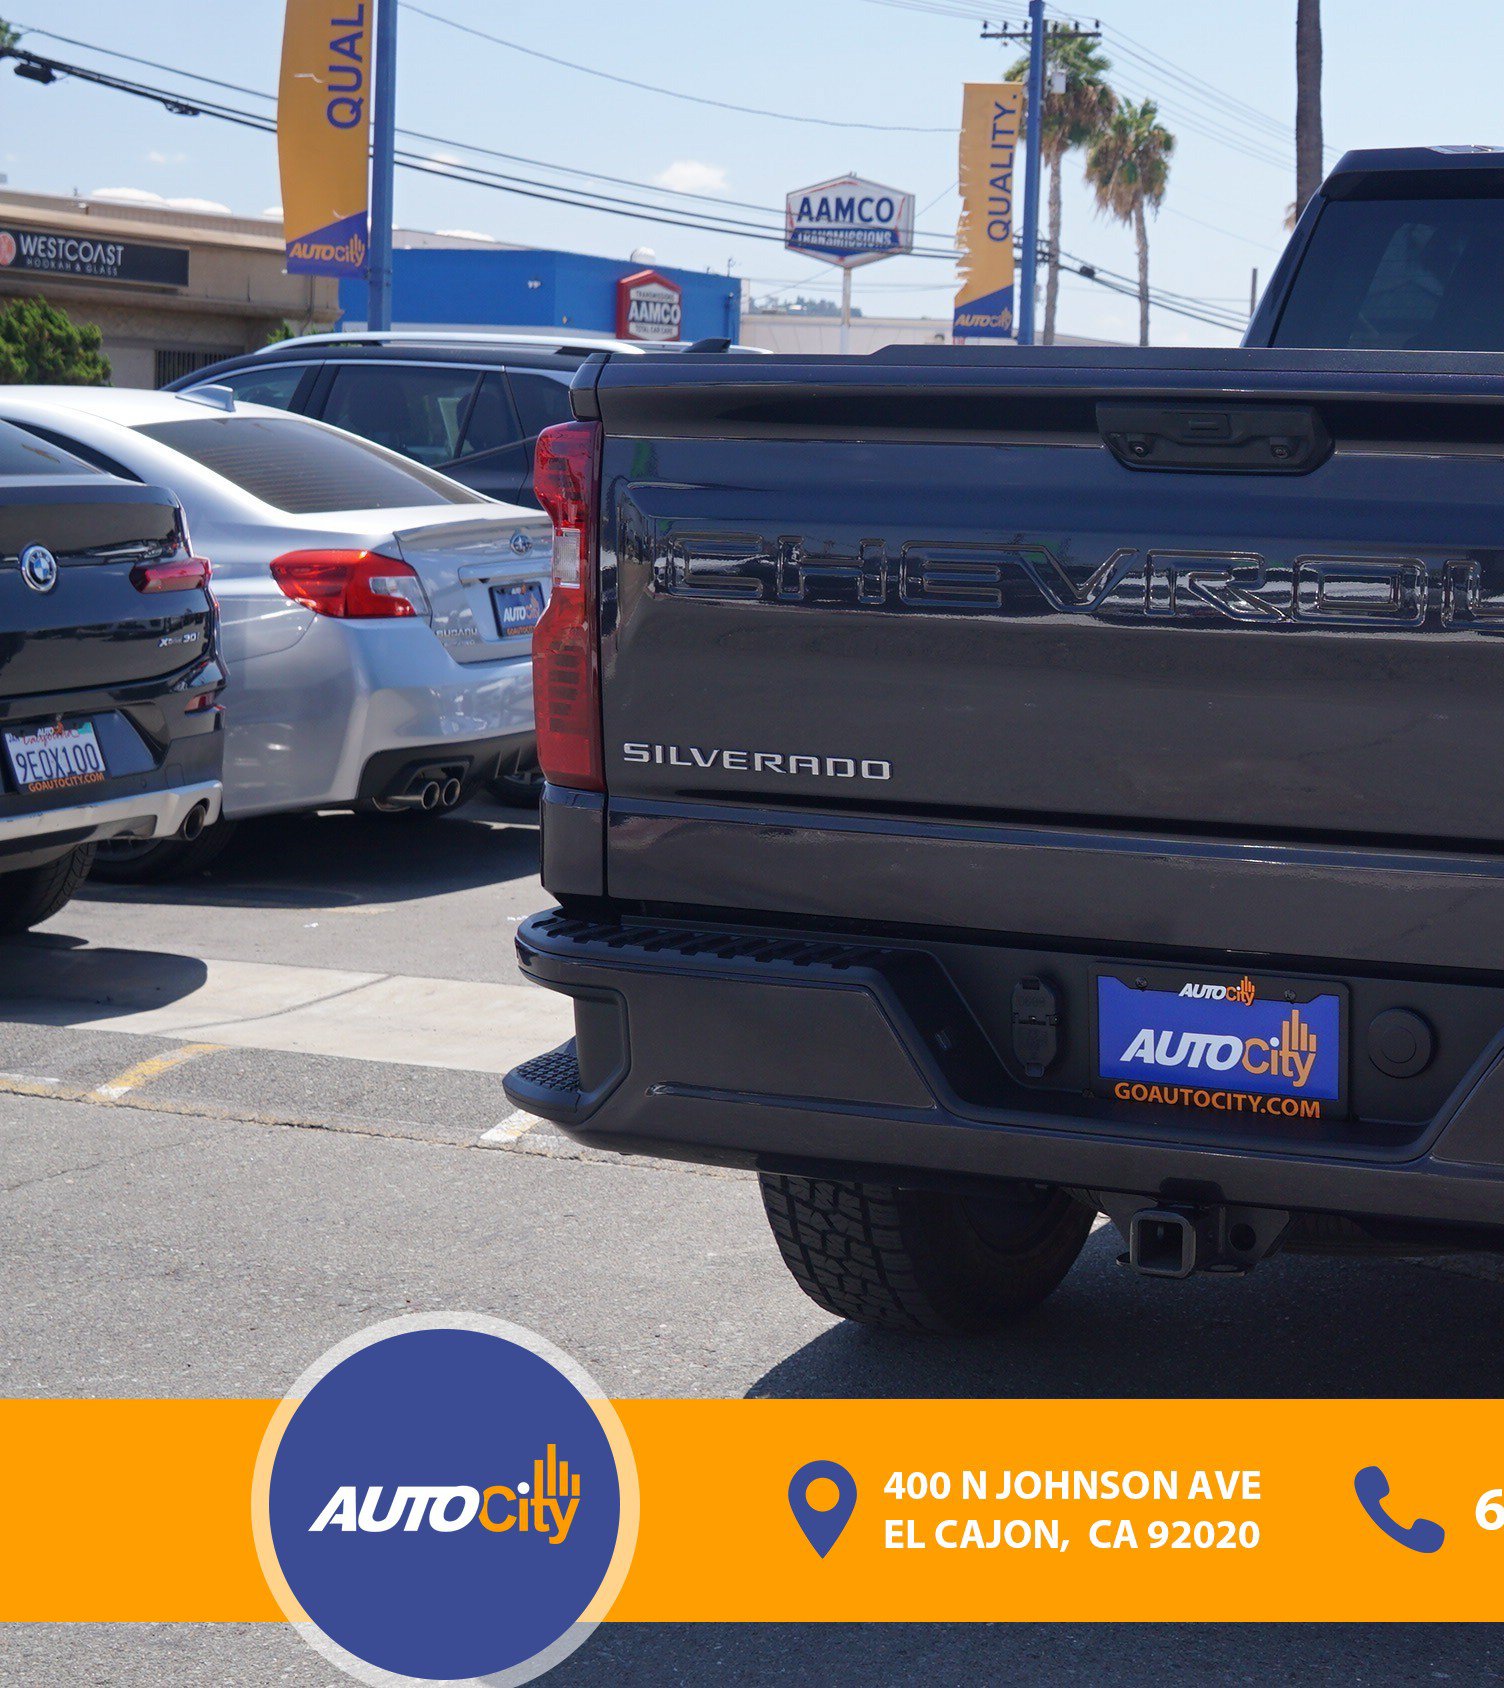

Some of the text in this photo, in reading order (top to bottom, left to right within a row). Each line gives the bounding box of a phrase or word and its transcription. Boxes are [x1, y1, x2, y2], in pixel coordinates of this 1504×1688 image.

[797, 196, 894, 223] AAMCO
[20, 233, 124, 266] WESTCOAST
[628, 300, 681, 324] AAMCO
[623, 742, 892, 780] SILVERADO
[28, 773, 105, 792] GOAUTOCITY.COM
[1114, 1082, 1321, 1119] GOAUTOCITY.COM
